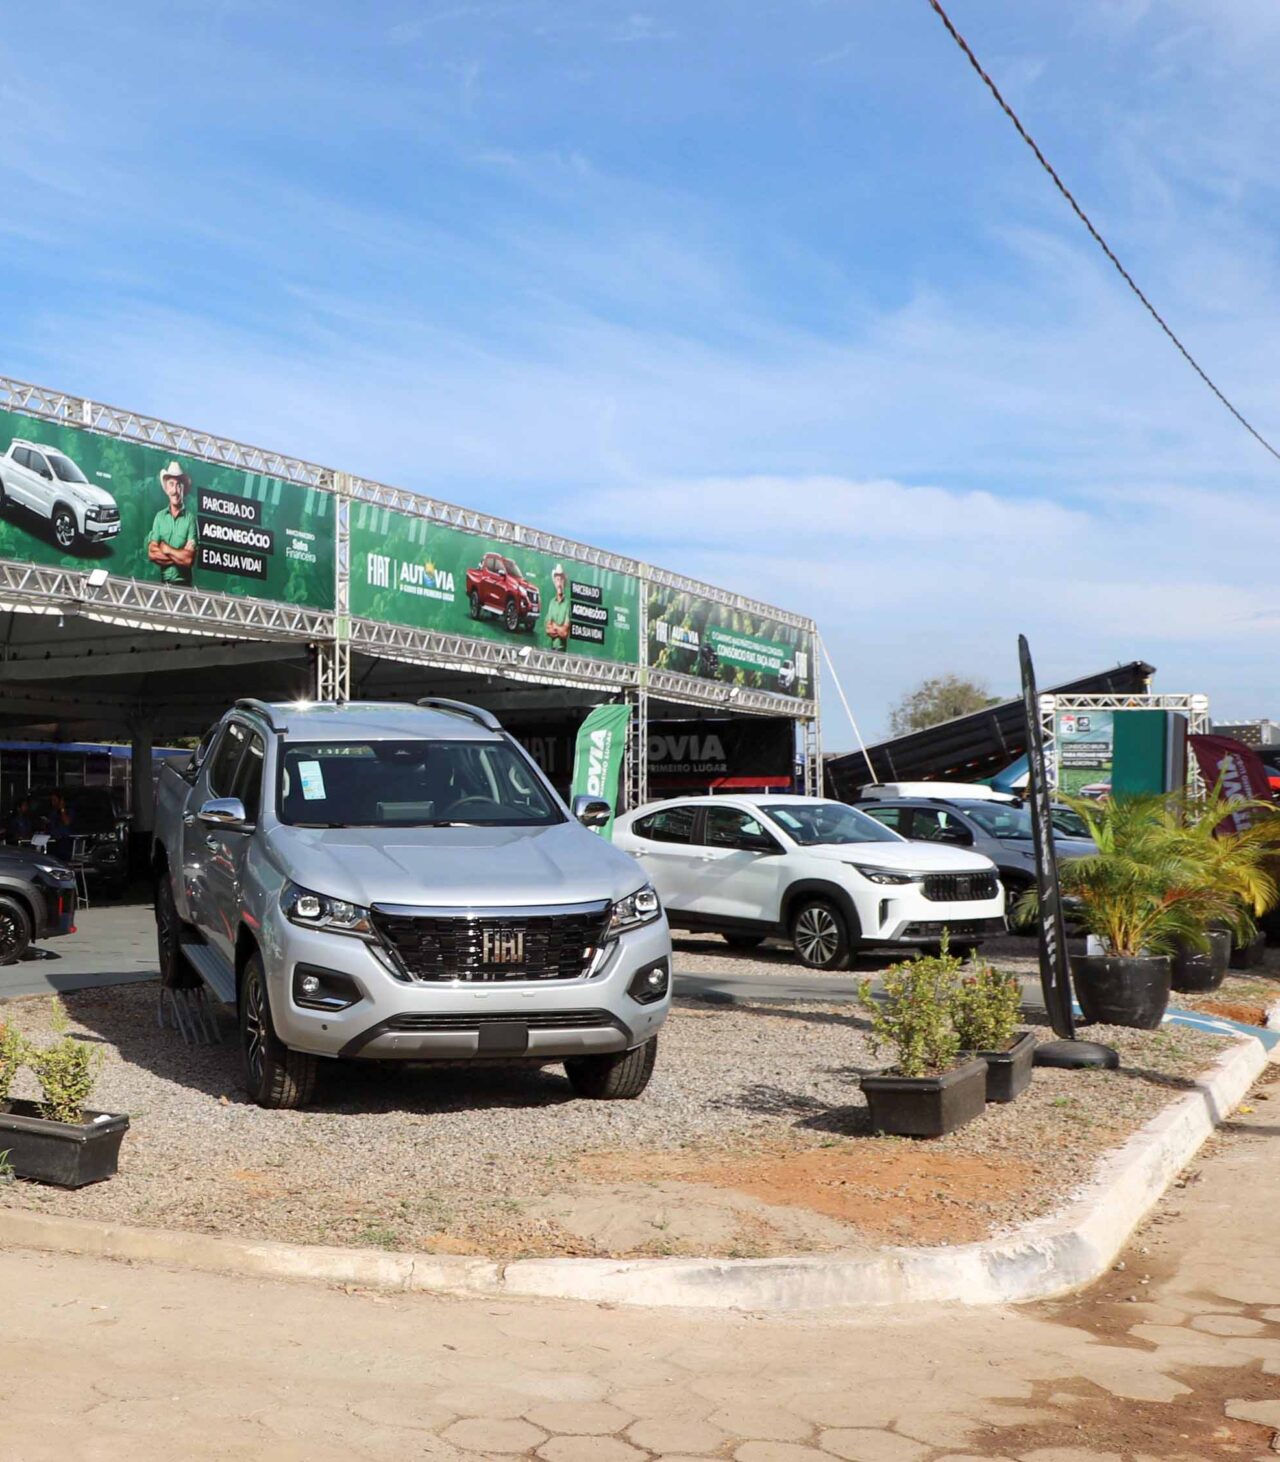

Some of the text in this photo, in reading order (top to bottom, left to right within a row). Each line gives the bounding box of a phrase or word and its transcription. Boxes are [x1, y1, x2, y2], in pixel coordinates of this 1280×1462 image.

[202, 496, 255, 519] PARCEIRA DO
[202, 523, 271, 549] AGRONEGÓCIO
[202, 550, 209, 563] E
[209, 550, 222, 566] DA
[223, 553, 240, 569] SUA
[367, 552, 391, 588] FIAT
[400, 561, 455, 592] AUTOVIA
[647, 735, 727, 761] OVIA
[587, 729, 607, 797] OVIA
[693, 764, 727, 773] LUGAR
[483, 928, 526, 963] FIAT
